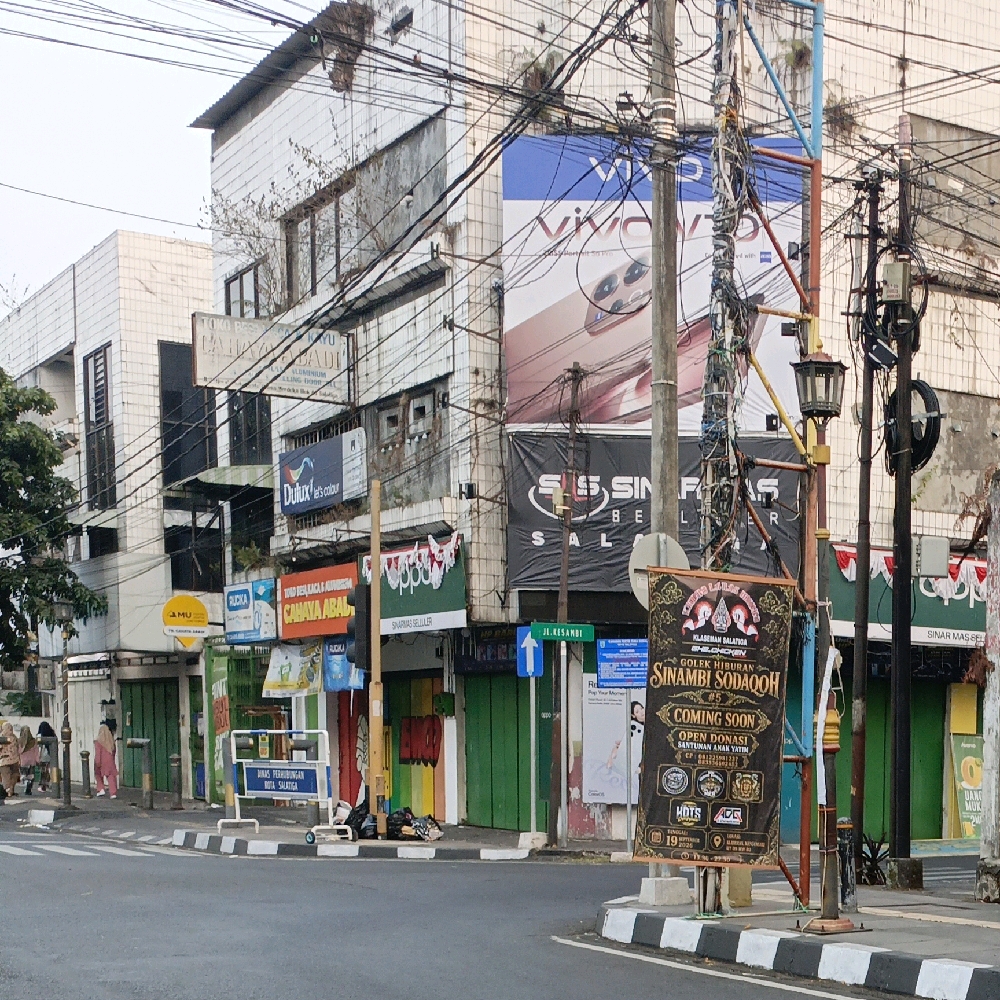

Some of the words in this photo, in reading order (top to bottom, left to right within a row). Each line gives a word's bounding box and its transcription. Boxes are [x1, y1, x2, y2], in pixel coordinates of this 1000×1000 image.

[283, 484, 312, 506] Dulux
[284, 600, 322, 624] CAHAYA
[722, 637, 748, 646] SALATIGA
[927, 630, 951, 641] SINAR
[953, 632, 969, 641] MAS
[680, 658, 711, 669] GOLEK
[714, 661, 755, 672] HIBURAN
[650, 662, 711, 689] SINAMBI
[714, 671, 781, 700] SODAQOH
[708, 693, 722, 703] #5
[673, 709, 722, 729] COMING
[725, 713, 756, 729] SOON
[678, 731, 708, 742] OPEN
[710, 733, 749, 746] DONASI
[677, 741, 712, 751] SANTUNAN
[666, 835, 678, 847] 19
